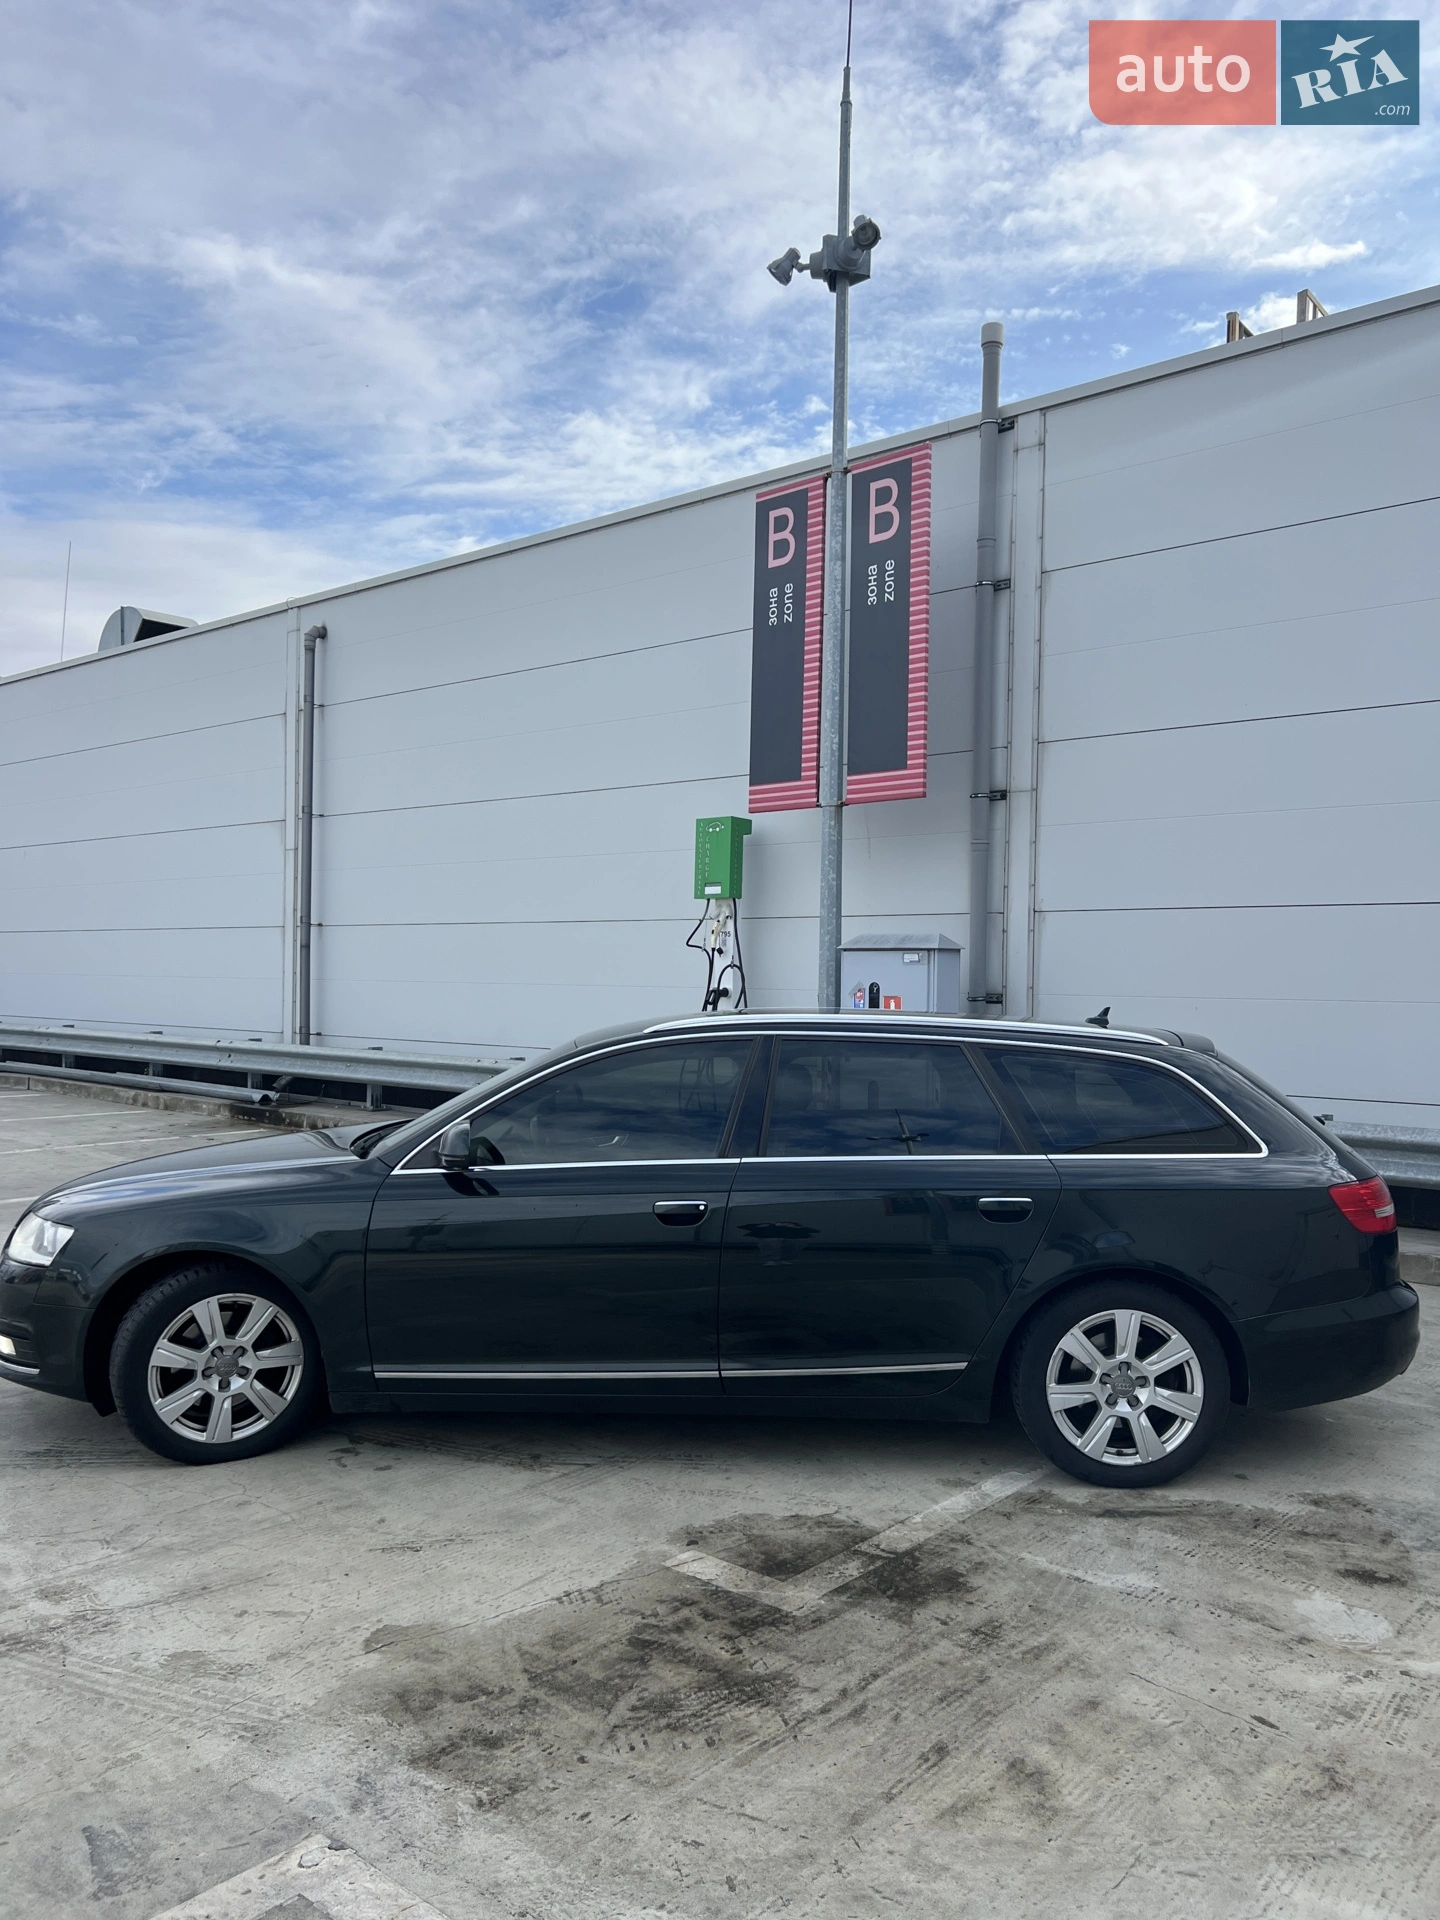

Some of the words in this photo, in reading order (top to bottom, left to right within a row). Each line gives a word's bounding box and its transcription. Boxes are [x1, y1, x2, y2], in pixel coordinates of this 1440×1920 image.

[868, 477, 900, 544] B
[767, 506, 796, 569] B
[867, 563, 878, 606] зона
[884, 559, 895, 603] zone
[768, 586, 778, 626] зона
[783, 582, 794, 624] zone
